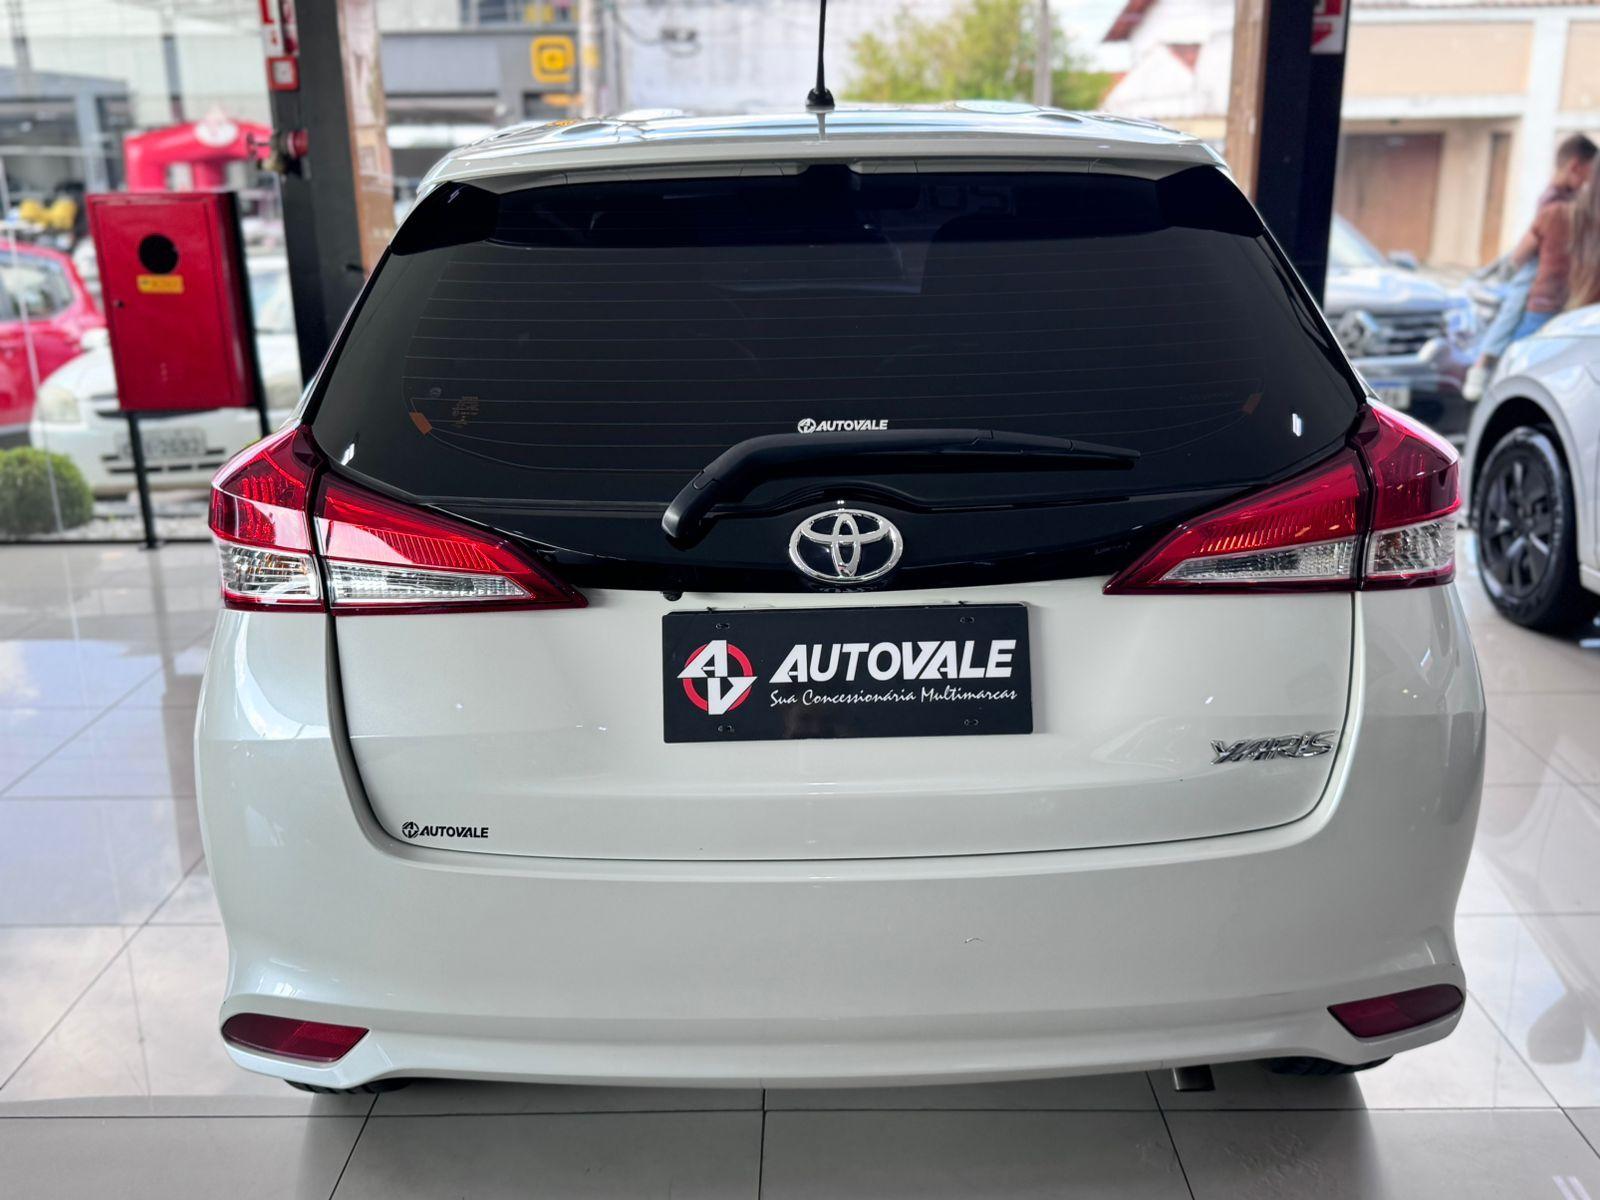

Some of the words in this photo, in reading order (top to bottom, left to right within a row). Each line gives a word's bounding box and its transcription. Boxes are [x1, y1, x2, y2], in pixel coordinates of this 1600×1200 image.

[816, 419, 889, 431] AUTOVALE
[769, 639, 1017, 684] AUTOVALE
[770, 689, 797, 707] Sua
[802, 688, 917, 706] Concessionária
[920, 684, 1018, 702] Multimarcas
[1210, 730, 1336, 765] YARIS
[420, 825, 489, 838] AUTOVALE
